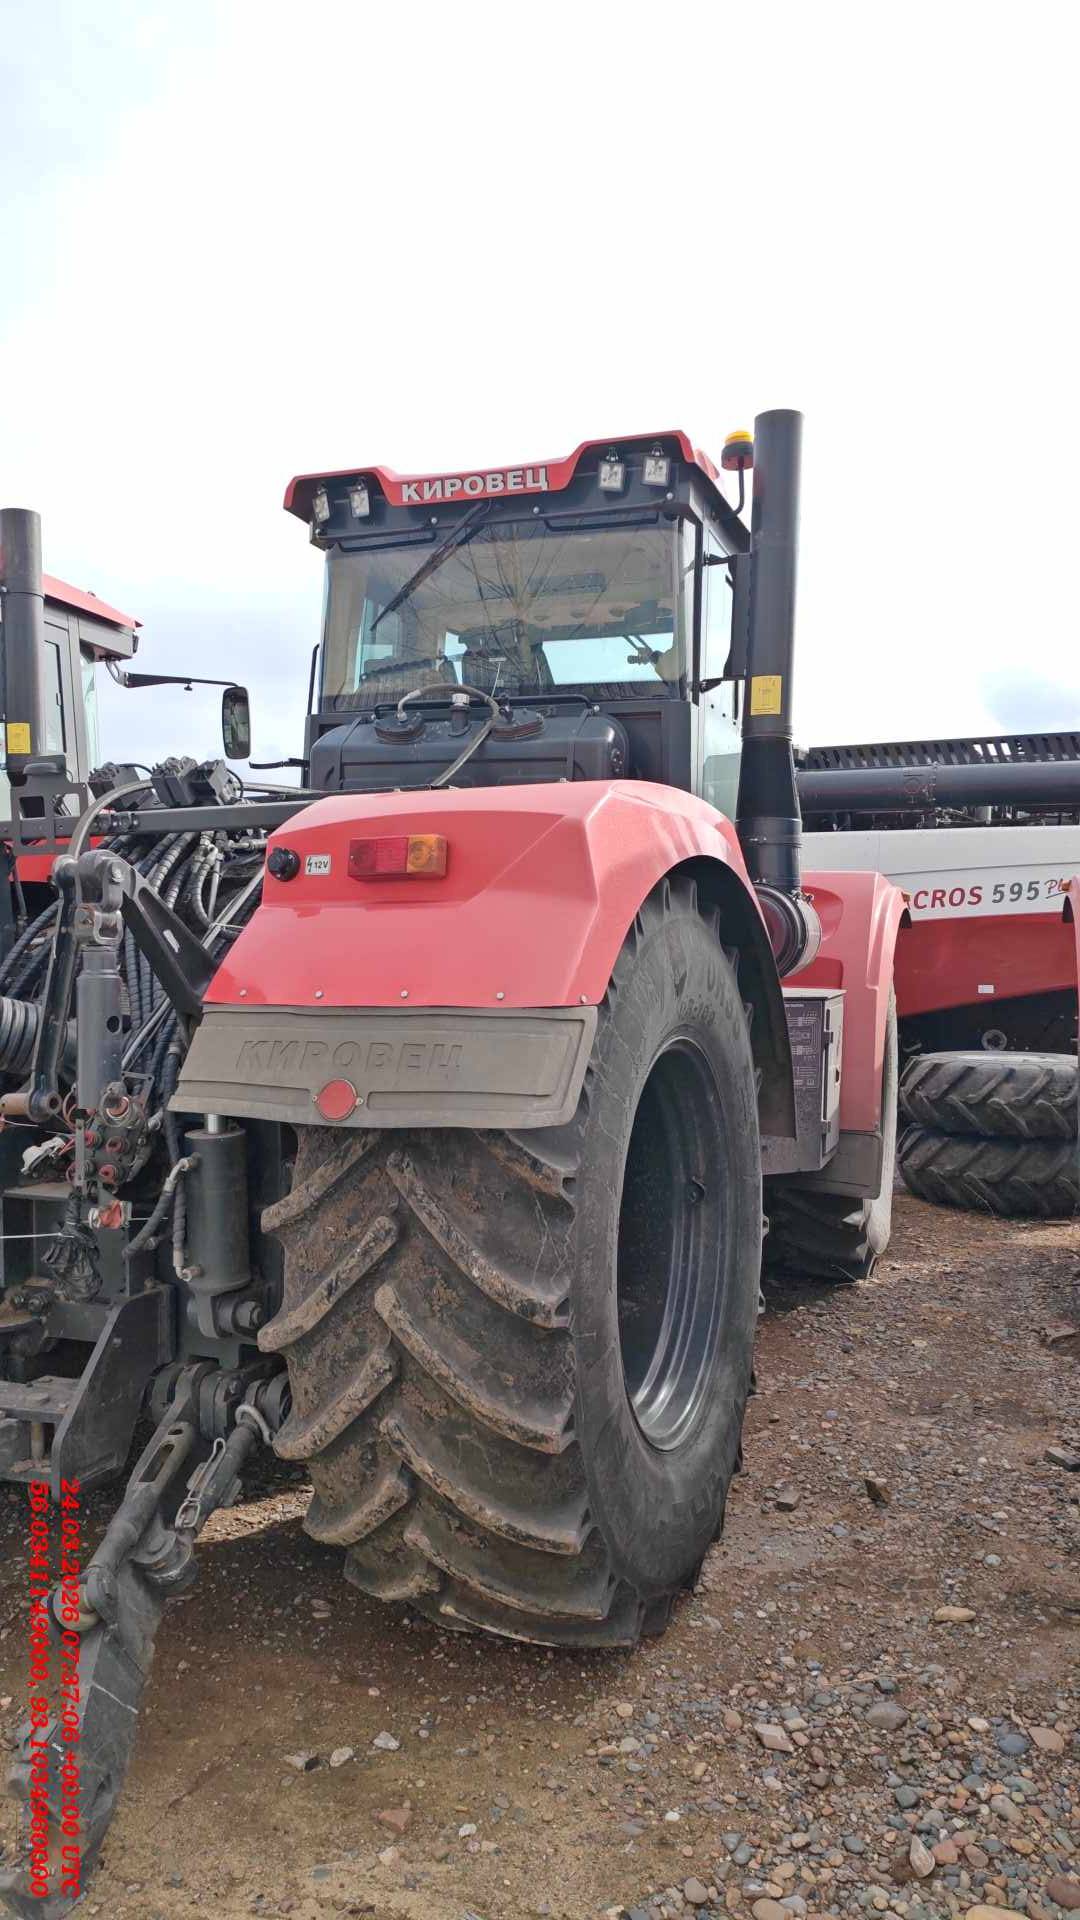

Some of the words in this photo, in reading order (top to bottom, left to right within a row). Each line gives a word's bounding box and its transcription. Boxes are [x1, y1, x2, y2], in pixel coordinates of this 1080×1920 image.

[401, 465, 549, 503] КИРОВЕЦ
[314, 860, 329, 869] 12V
[907, 886, 983, 911] CROS
[992, 880, 1040, 903] 595
[235, 1039, 464, 1075] КИРОВЕЦ
